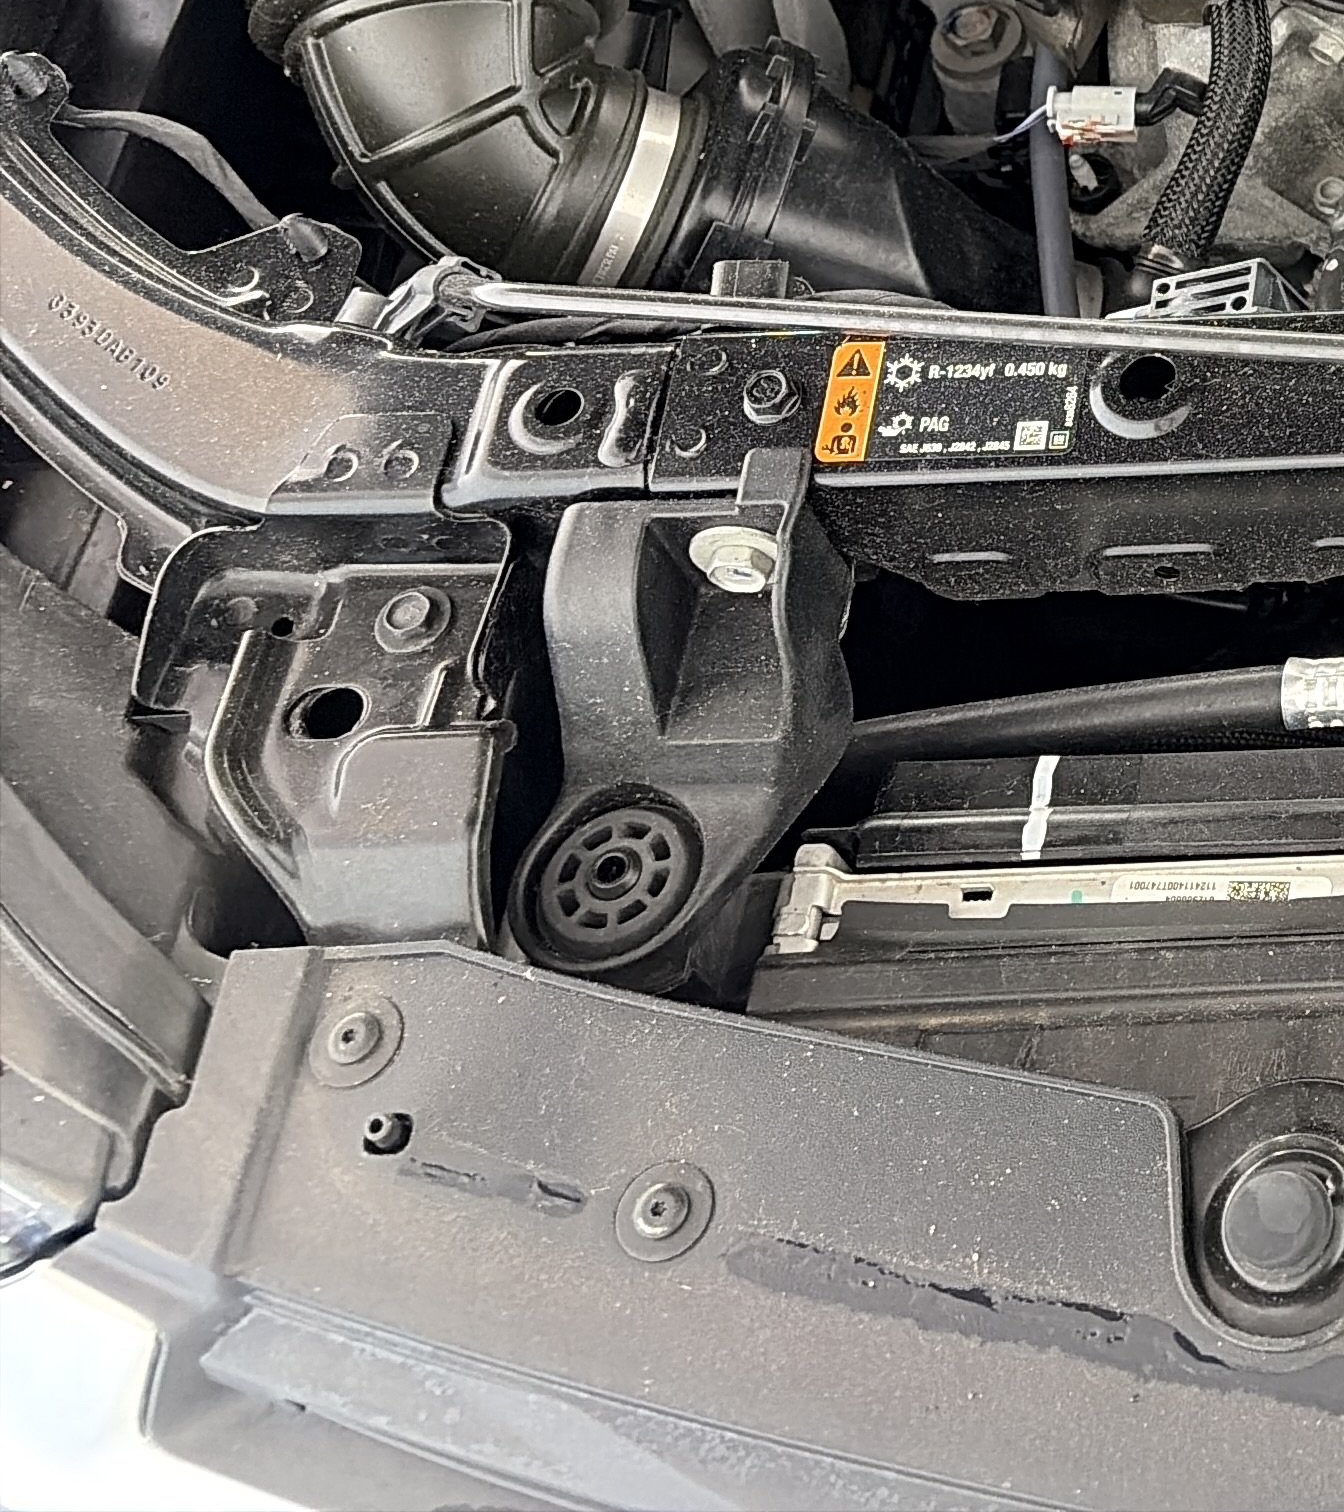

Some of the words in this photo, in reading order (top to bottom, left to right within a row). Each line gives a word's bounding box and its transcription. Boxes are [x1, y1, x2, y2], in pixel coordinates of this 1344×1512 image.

[927, 362, 996, 381] R-1234yf
[1004, 362, 1045, 377] 0.450
[1048, 361, 1068, 379] kg
[919, 416, 950, 432] PAG
[900, 443, 919, 453] SAE
